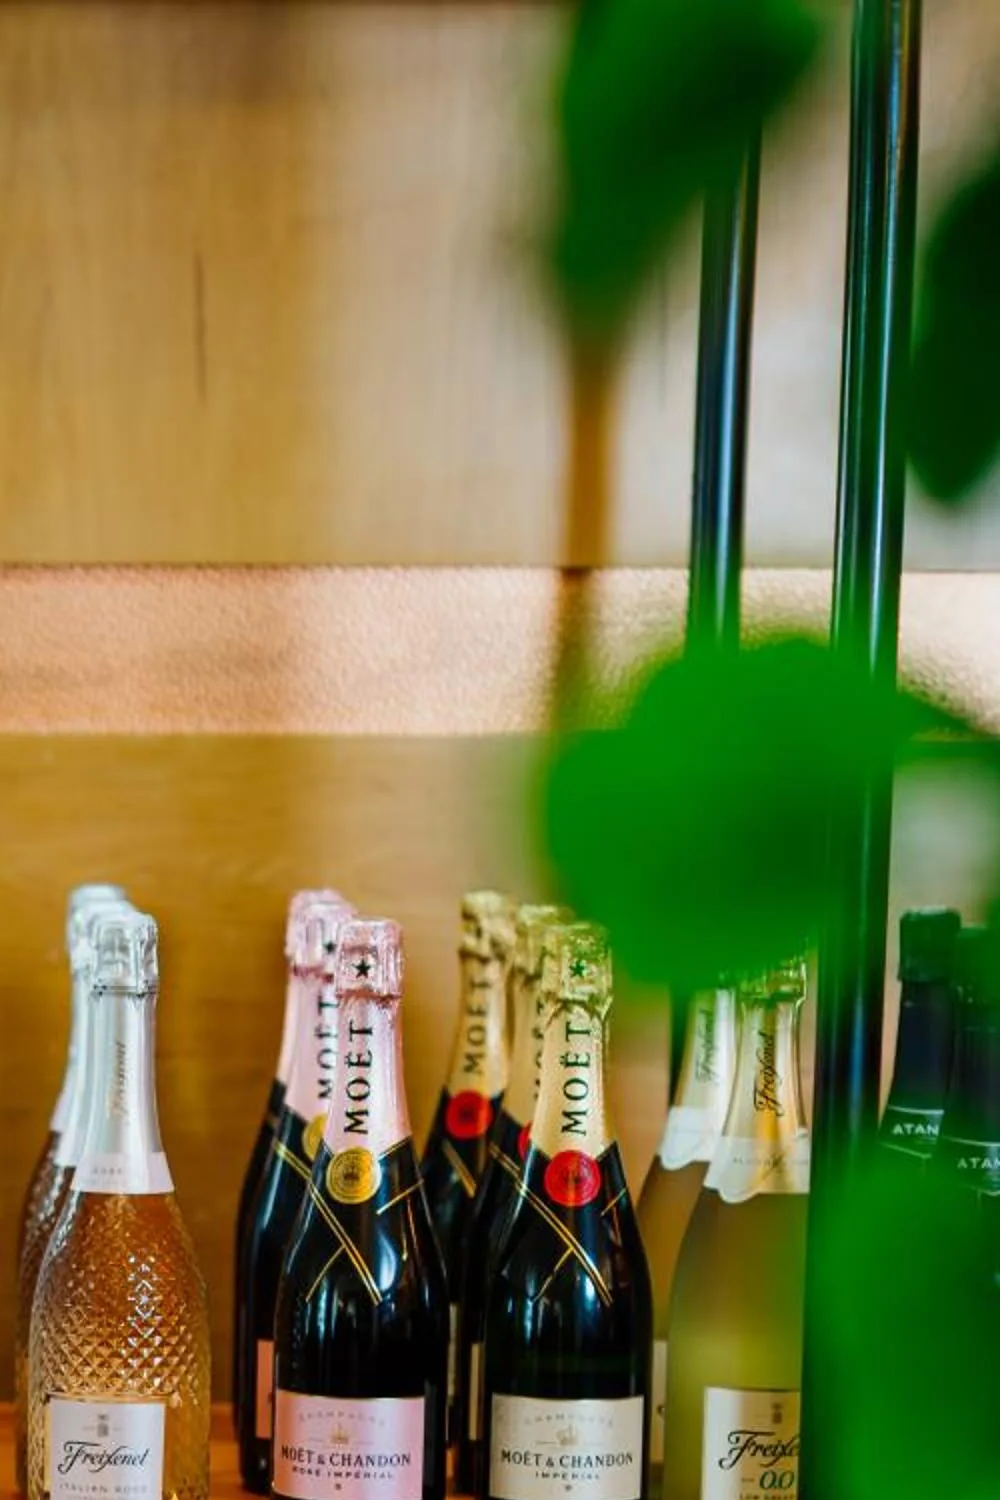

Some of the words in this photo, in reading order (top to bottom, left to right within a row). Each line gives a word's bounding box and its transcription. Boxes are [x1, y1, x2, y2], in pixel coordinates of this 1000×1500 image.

[344, 1020, 372, 1134] MOËT
[560, 1021, 591, 1136] MOËT
[892, 1123, 939, 1136] ATAN
[57, 1440, 150, 1475] Freixenet
[329, 1452, 411, 1467] CHANDON
[559, 1451, 633, 1469] CHANDON
[718, 1429, 799, 1470] Freixe
